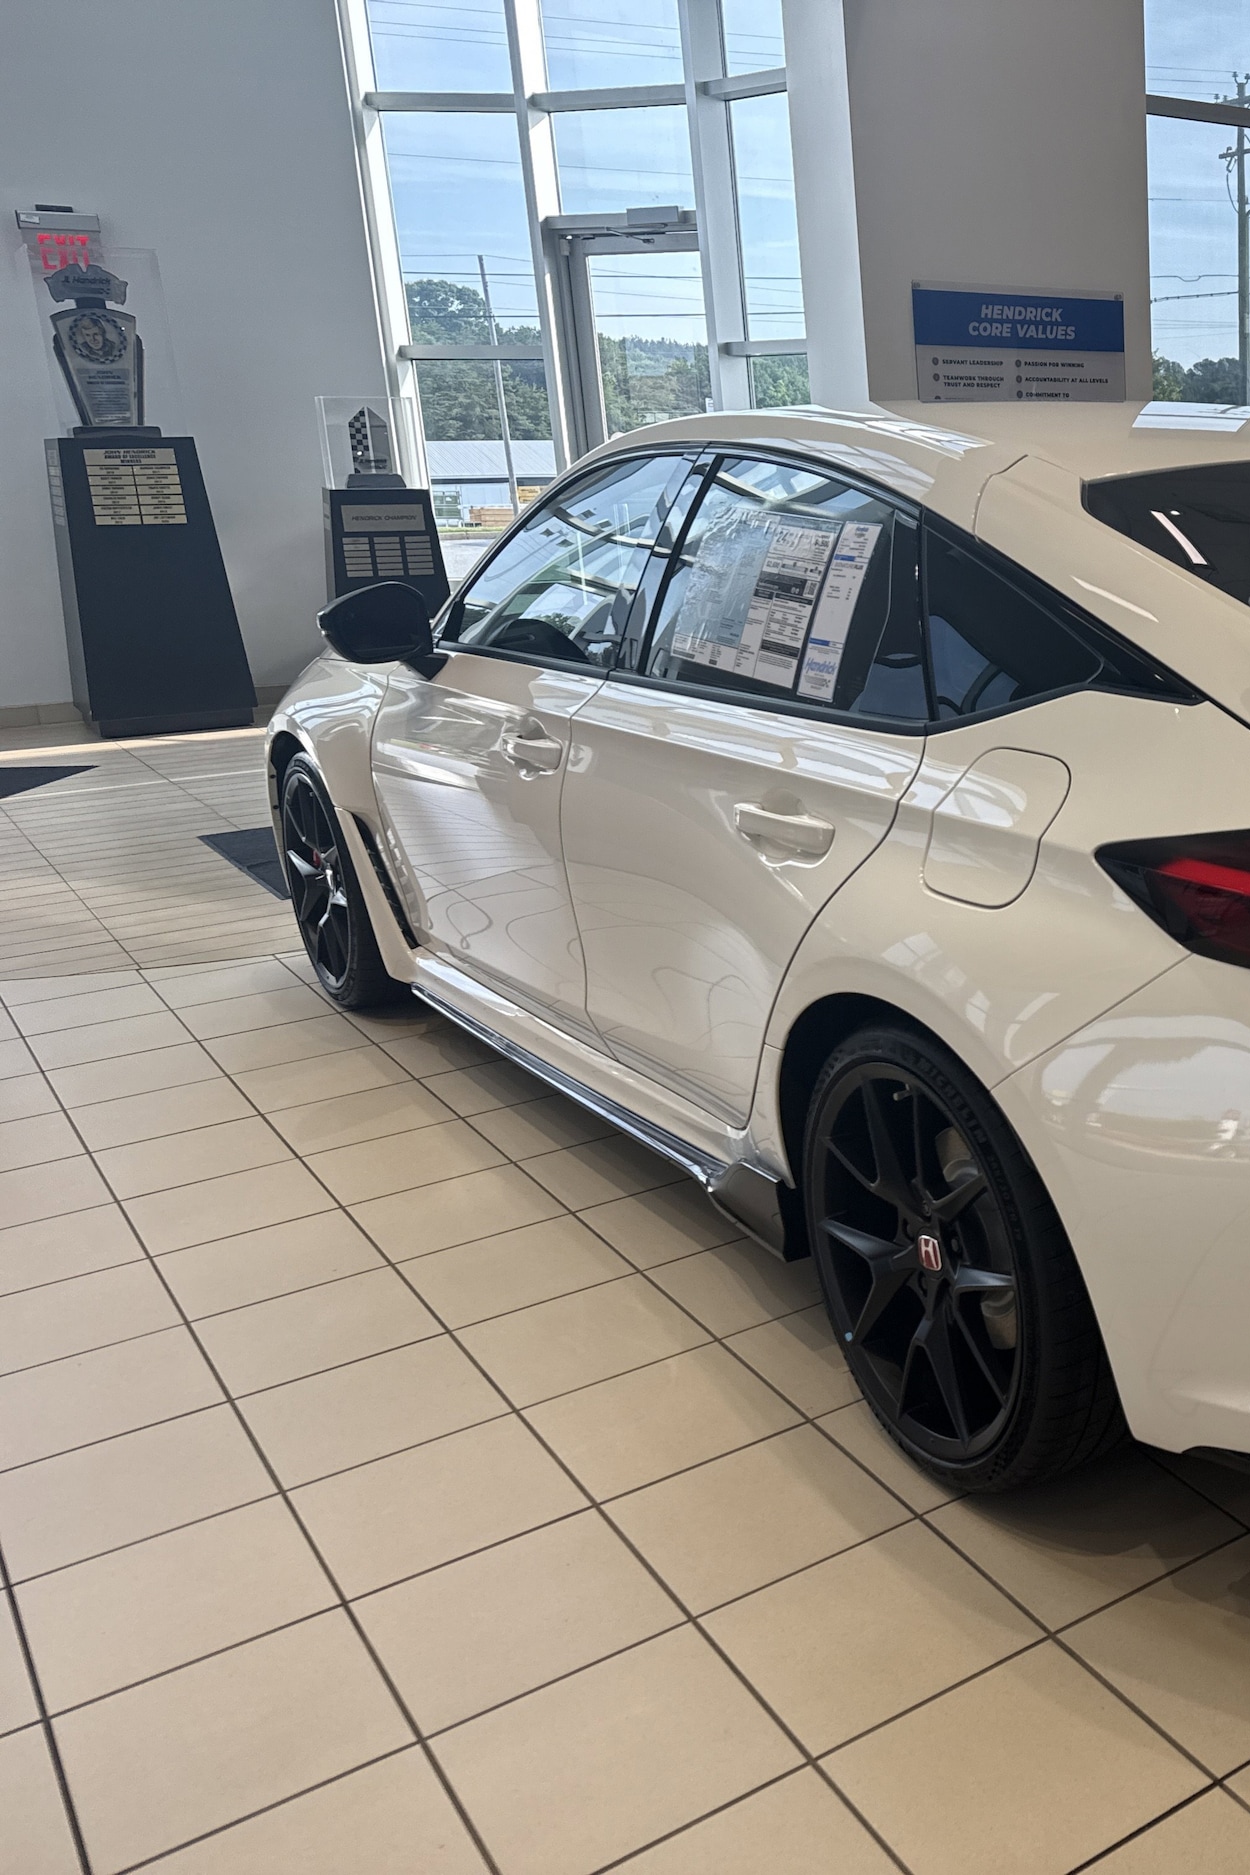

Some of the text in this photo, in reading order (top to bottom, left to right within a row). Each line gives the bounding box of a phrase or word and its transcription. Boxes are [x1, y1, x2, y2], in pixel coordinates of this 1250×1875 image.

[981, 304, 1063, 322] HENDRICK
[968, 322, 1076, 340] CORE VALUES
